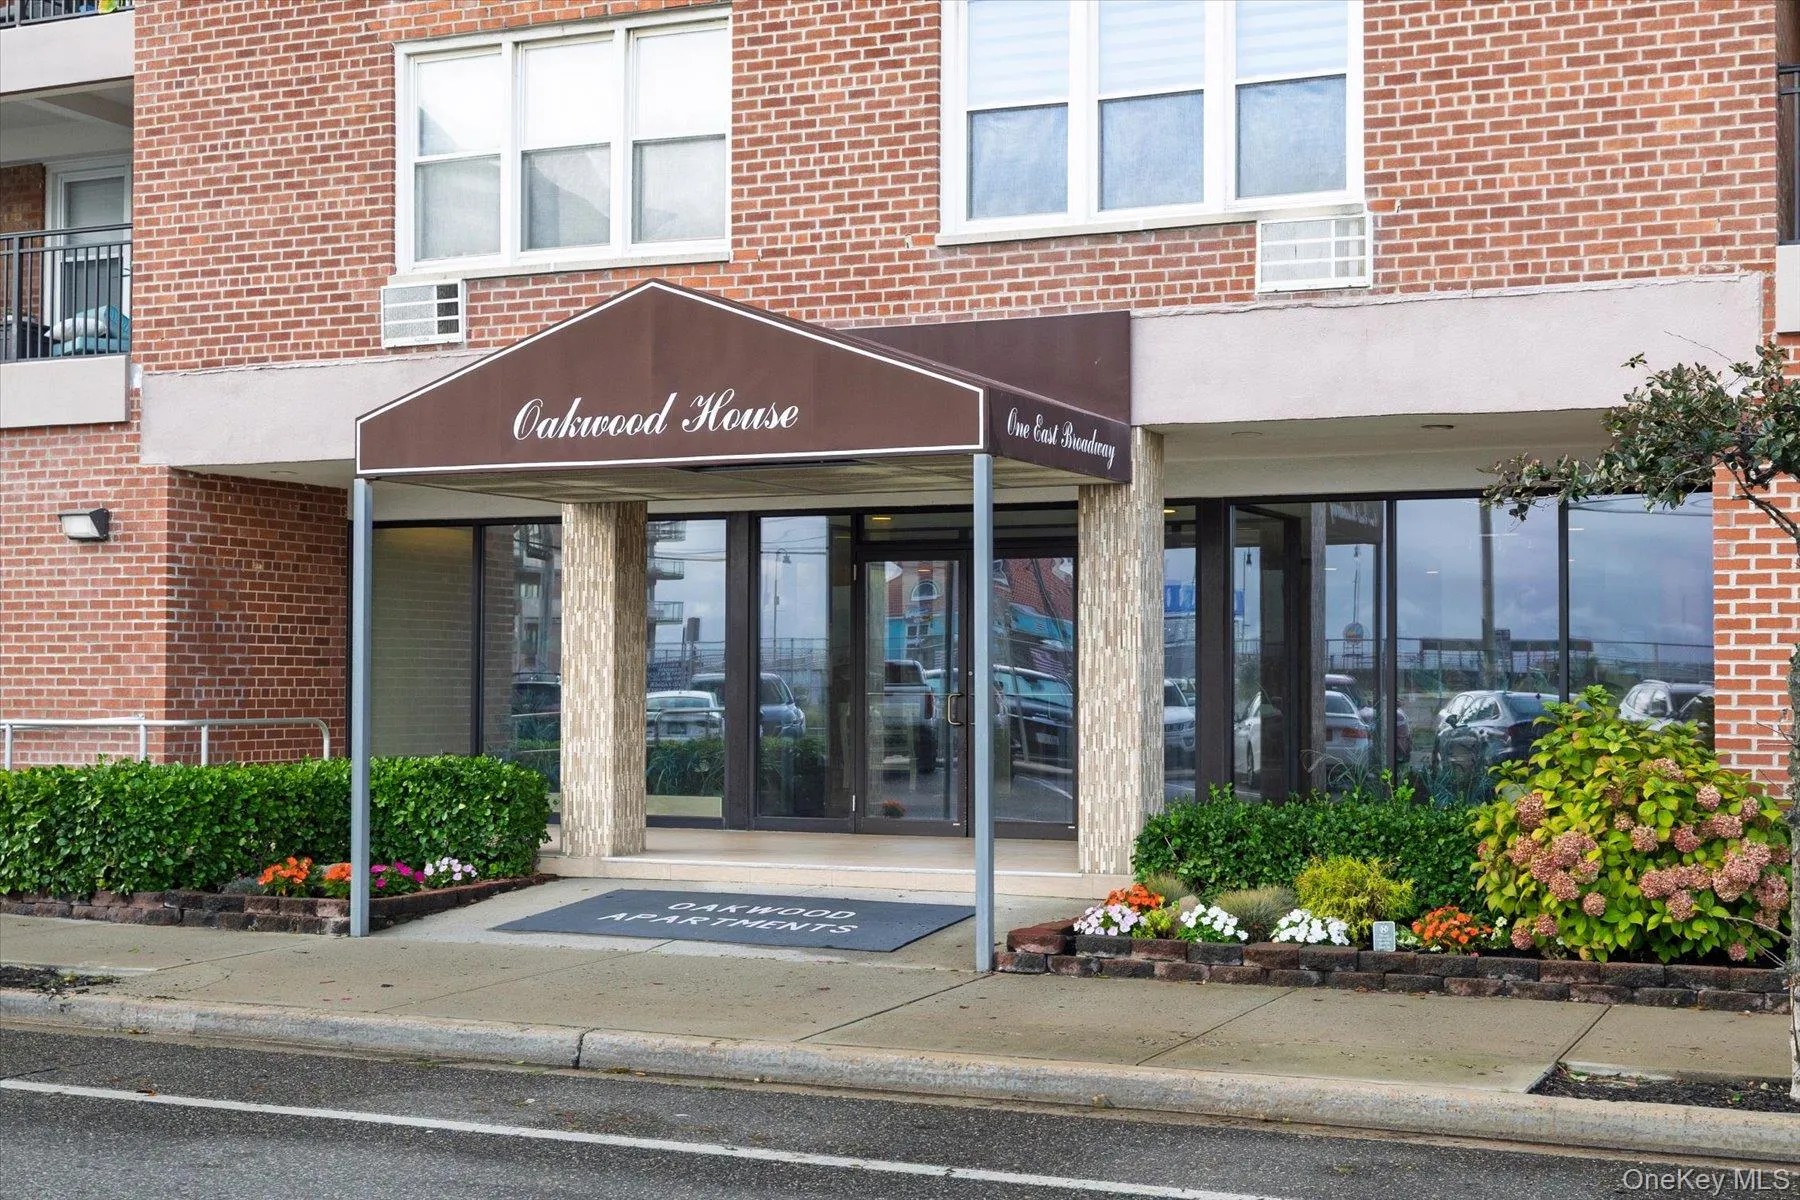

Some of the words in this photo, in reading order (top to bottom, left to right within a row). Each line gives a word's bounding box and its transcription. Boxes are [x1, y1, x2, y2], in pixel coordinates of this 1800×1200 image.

[512, 391, 678, 441] Oakwood
[681, 388, 800, 433] House
[1007, 407, 1030, 440] One
[1033, 413, 1059, 446] East
[1060, 421, 1116, 471] Broadway
[597, 912, 859, 935] APARTMENTS
[668, 902, 857, 920] OAKWOOD
